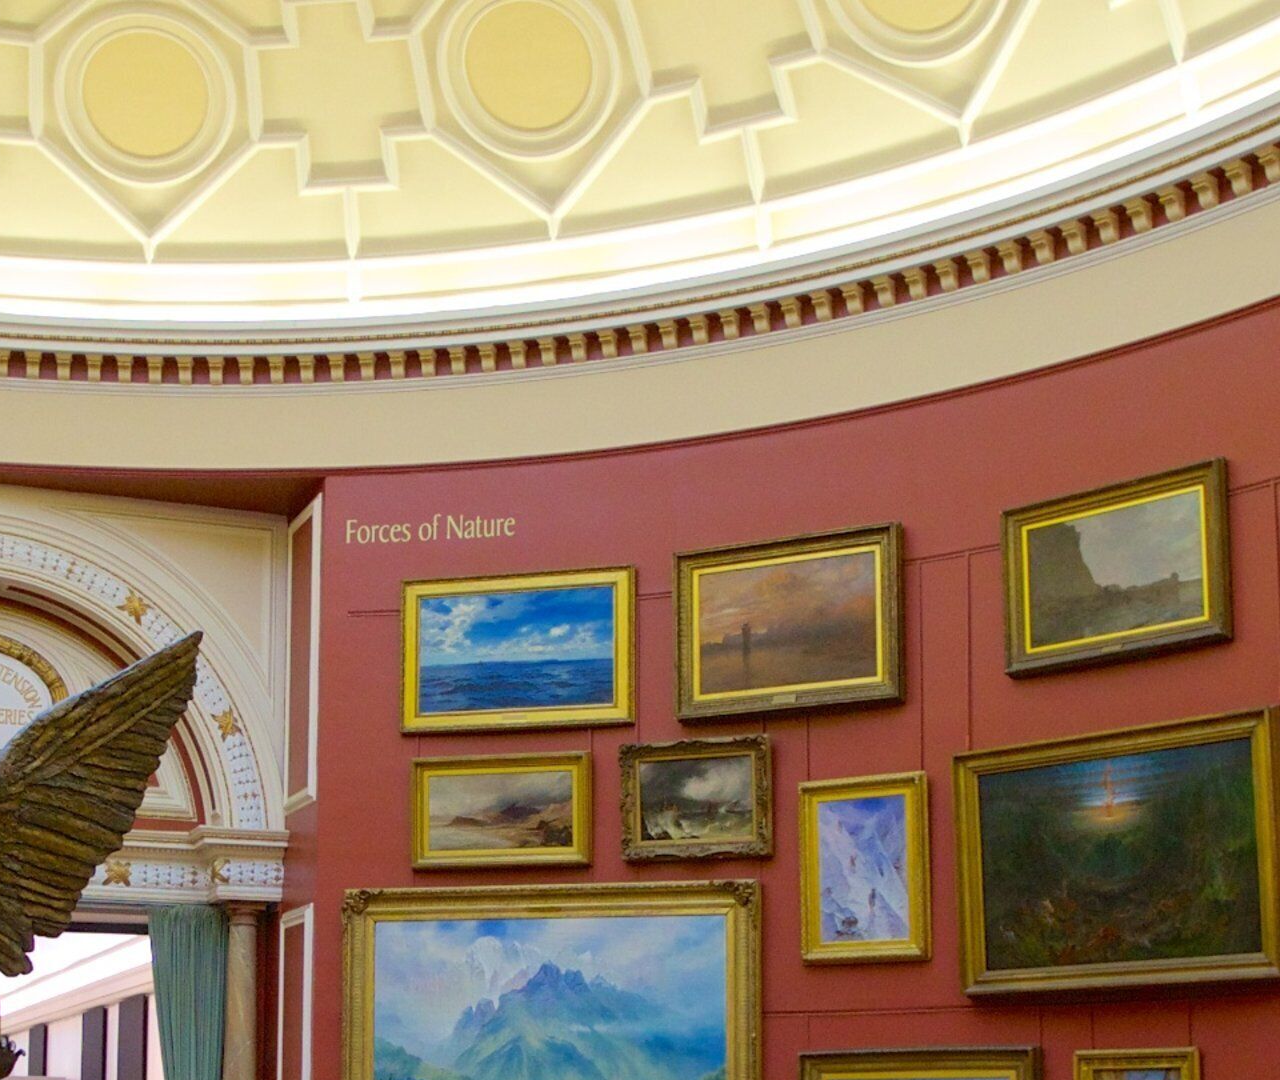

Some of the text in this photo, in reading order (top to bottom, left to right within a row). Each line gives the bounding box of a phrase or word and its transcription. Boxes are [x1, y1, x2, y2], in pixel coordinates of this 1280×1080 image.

[345, 513, 516, 544] Forces of Nature
